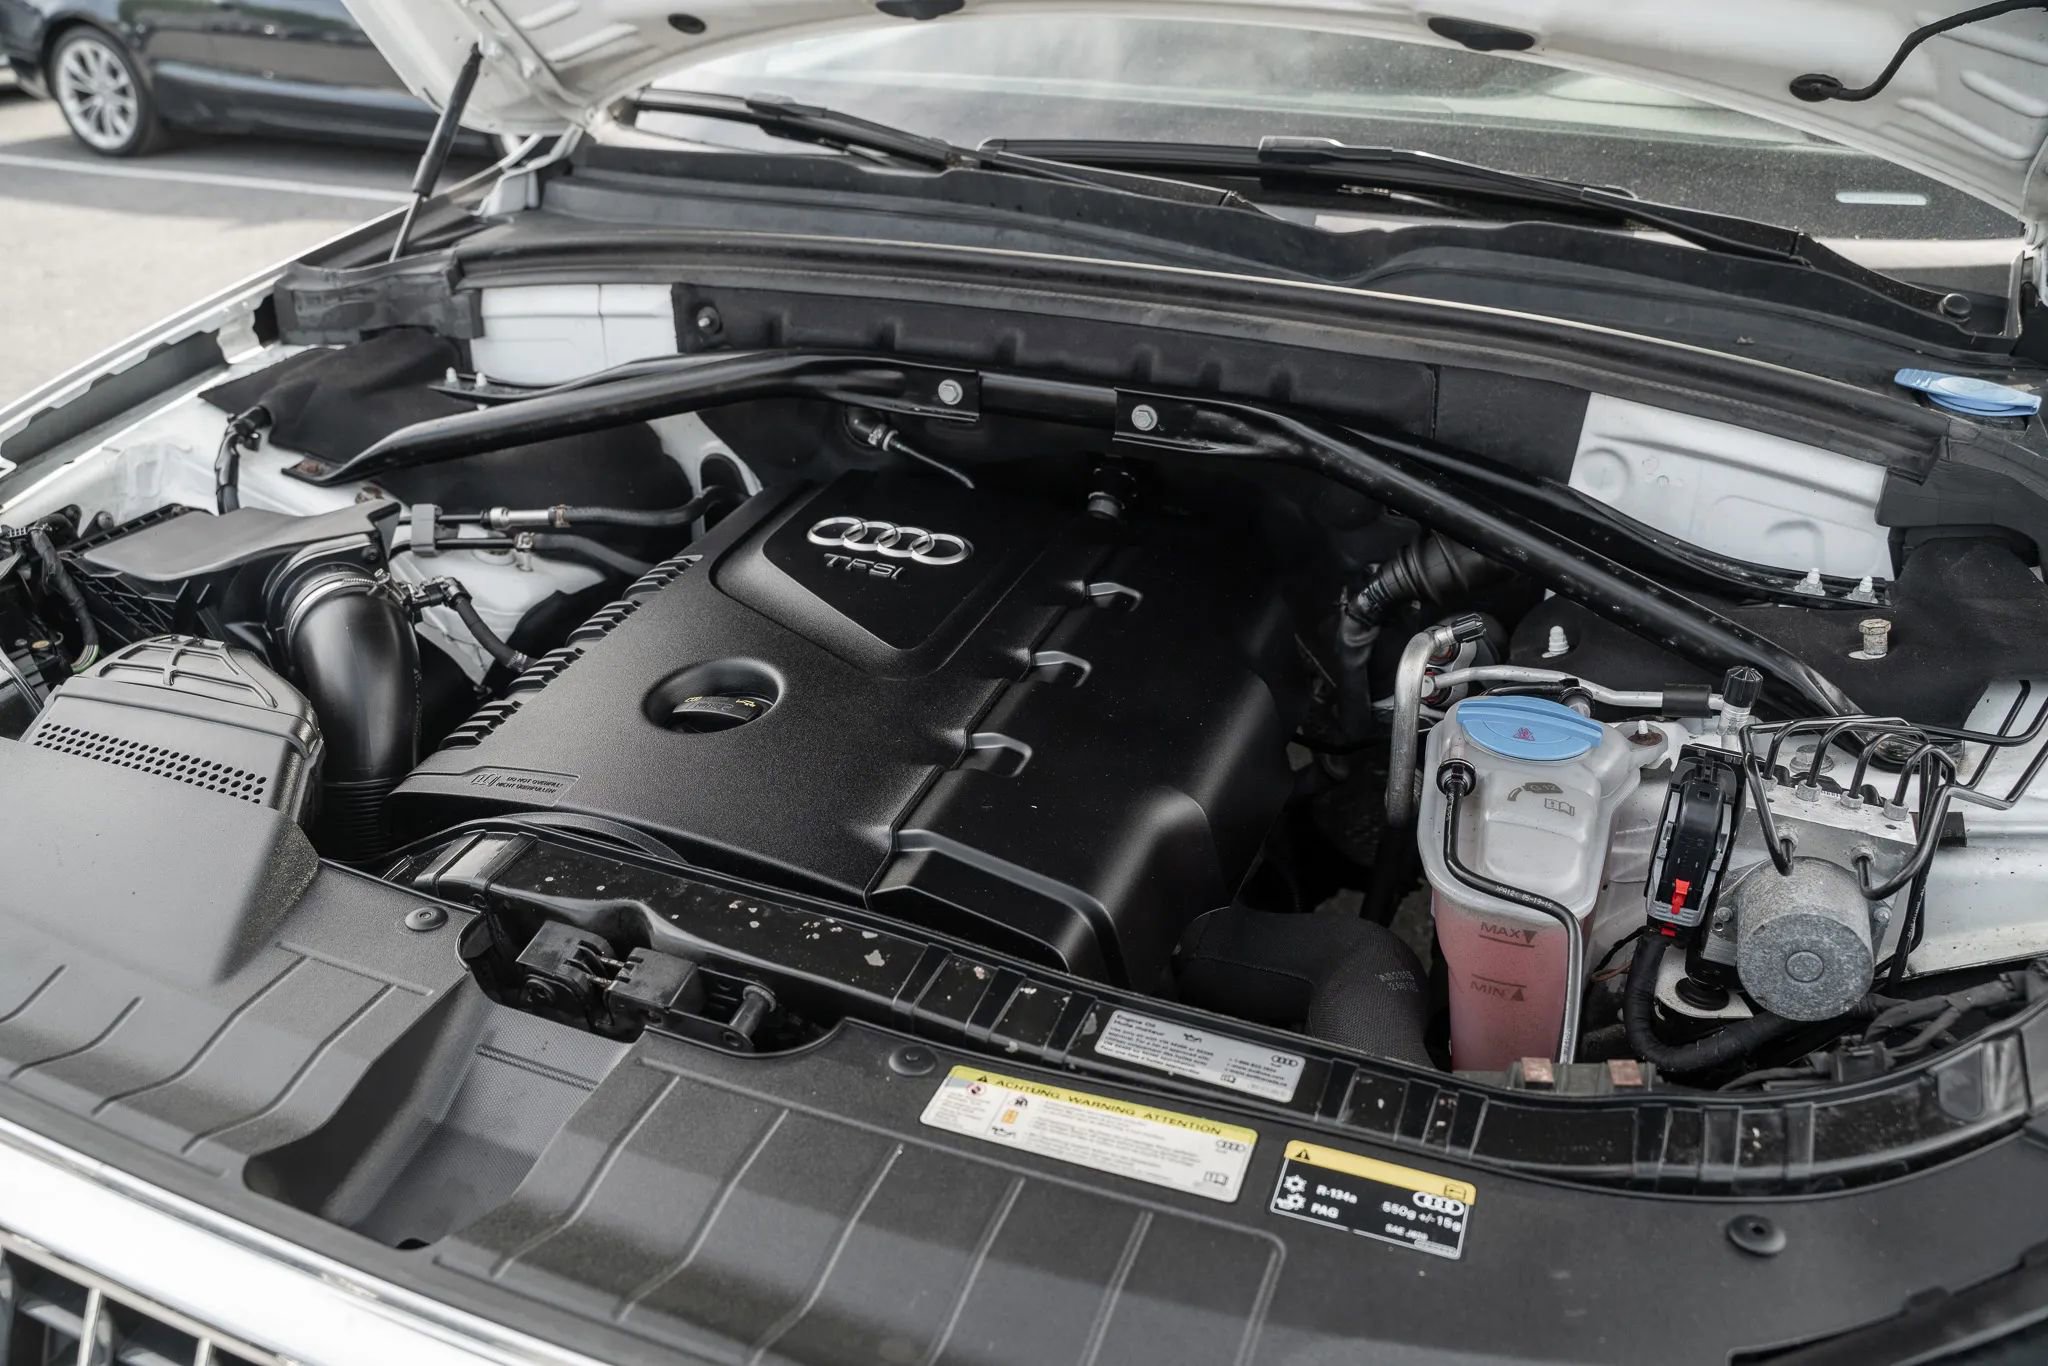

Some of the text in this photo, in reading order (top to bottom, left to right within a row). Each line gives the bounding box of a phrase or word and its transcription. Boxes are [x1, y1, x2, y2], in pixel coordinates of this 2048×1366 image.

[824, 553, 904, 580] TFSI
[1480, 921, 1521, 939] MAX
[1470, 981, 1506, 998] MIN
[995, 1079, 1222, 1136] ACHTUNG WARNING ATTENTION
[1310, 1202, 1340, 1219] PAG
